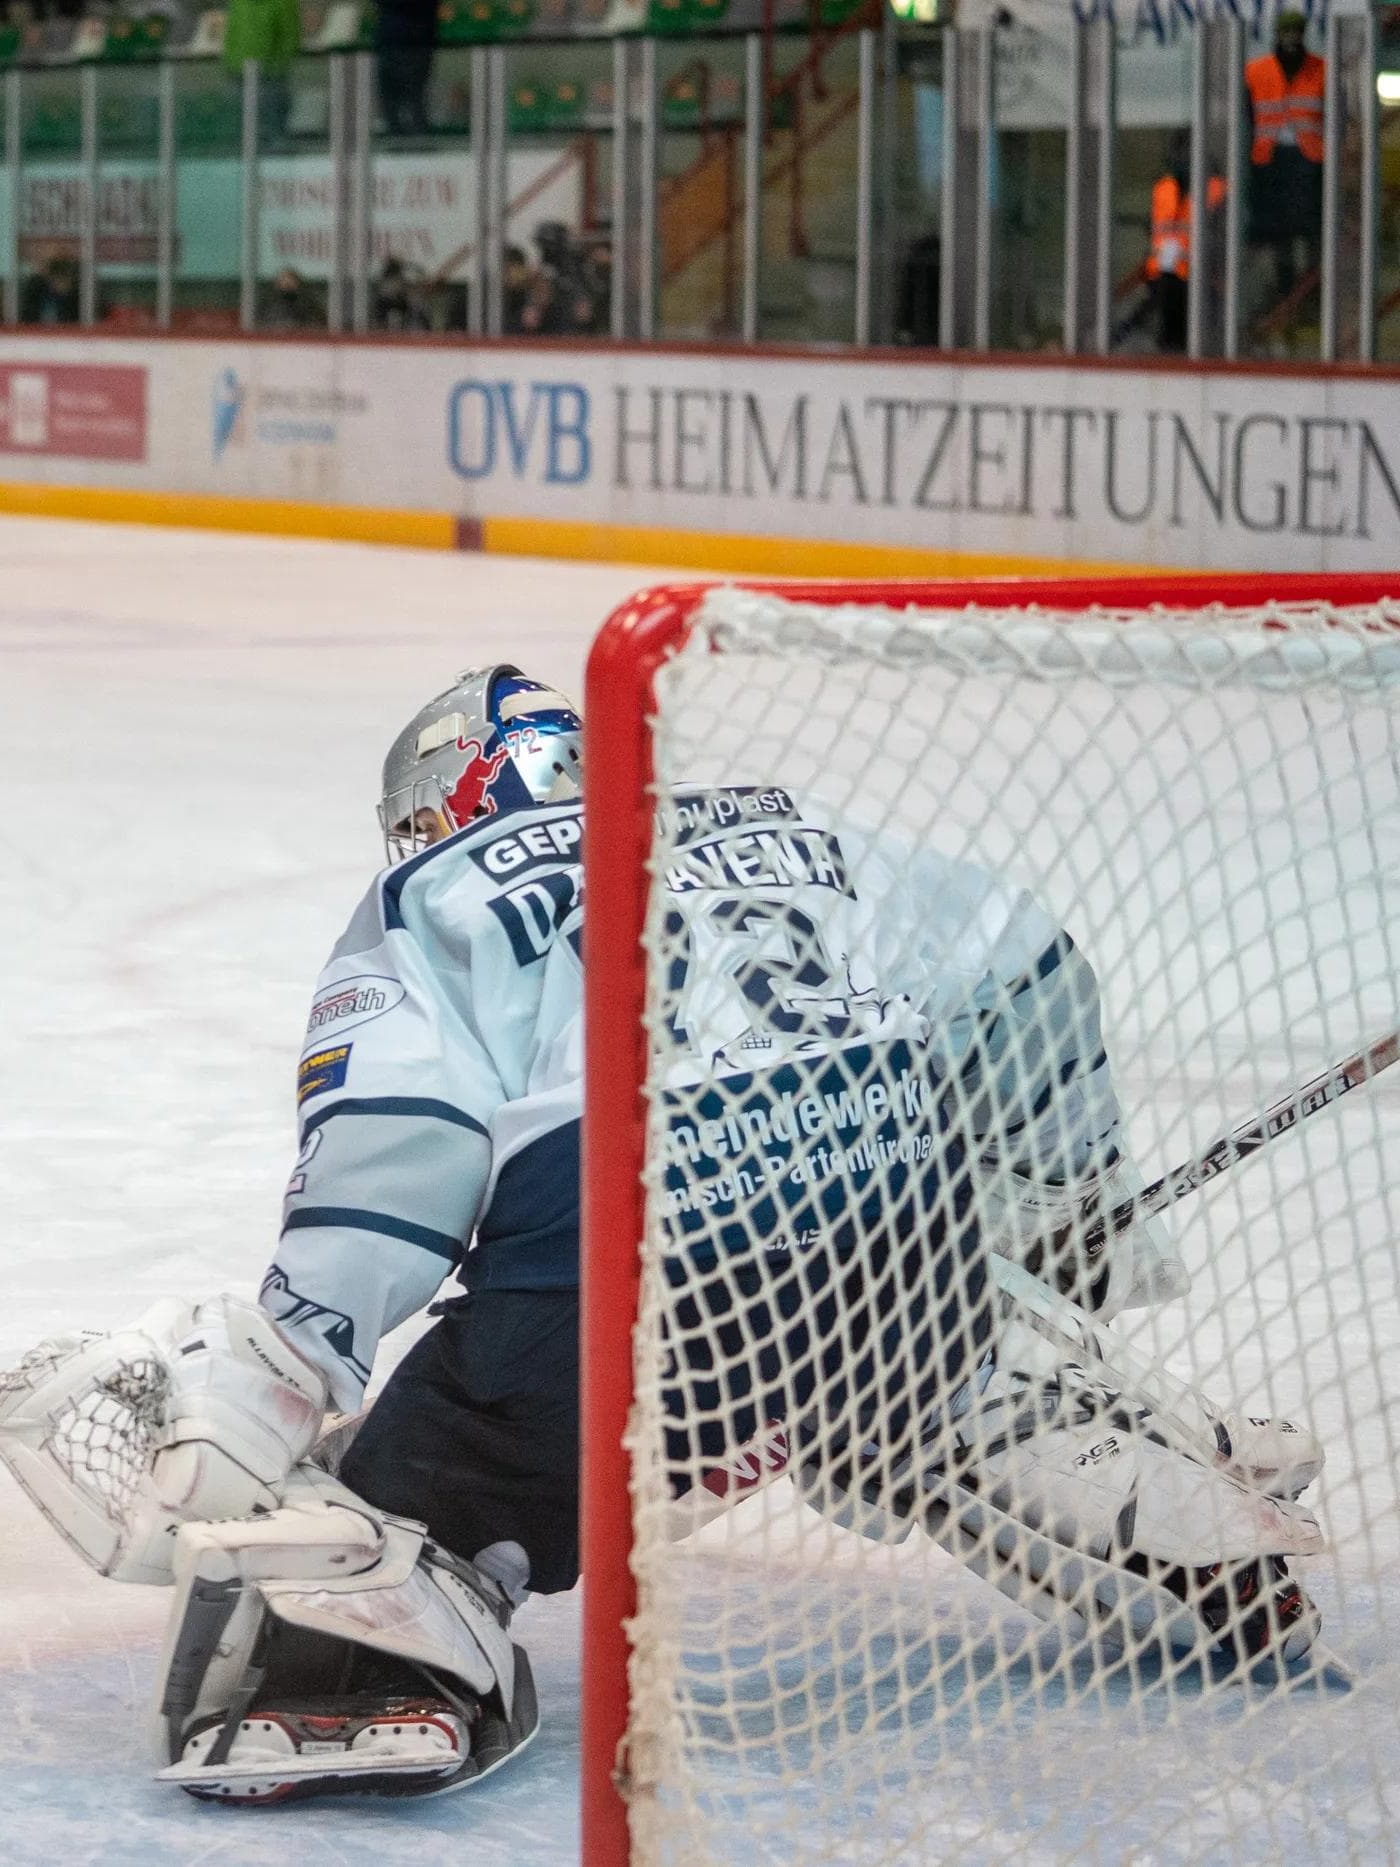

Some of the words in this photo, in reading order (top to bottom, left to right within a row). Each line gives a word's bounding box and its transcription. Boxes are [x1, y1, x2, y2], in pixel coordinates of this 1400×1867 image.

[446, 377, 593, 485] OVB
[505, 727, 542, 758] 72
[483, 817, 583, 875] GEP
